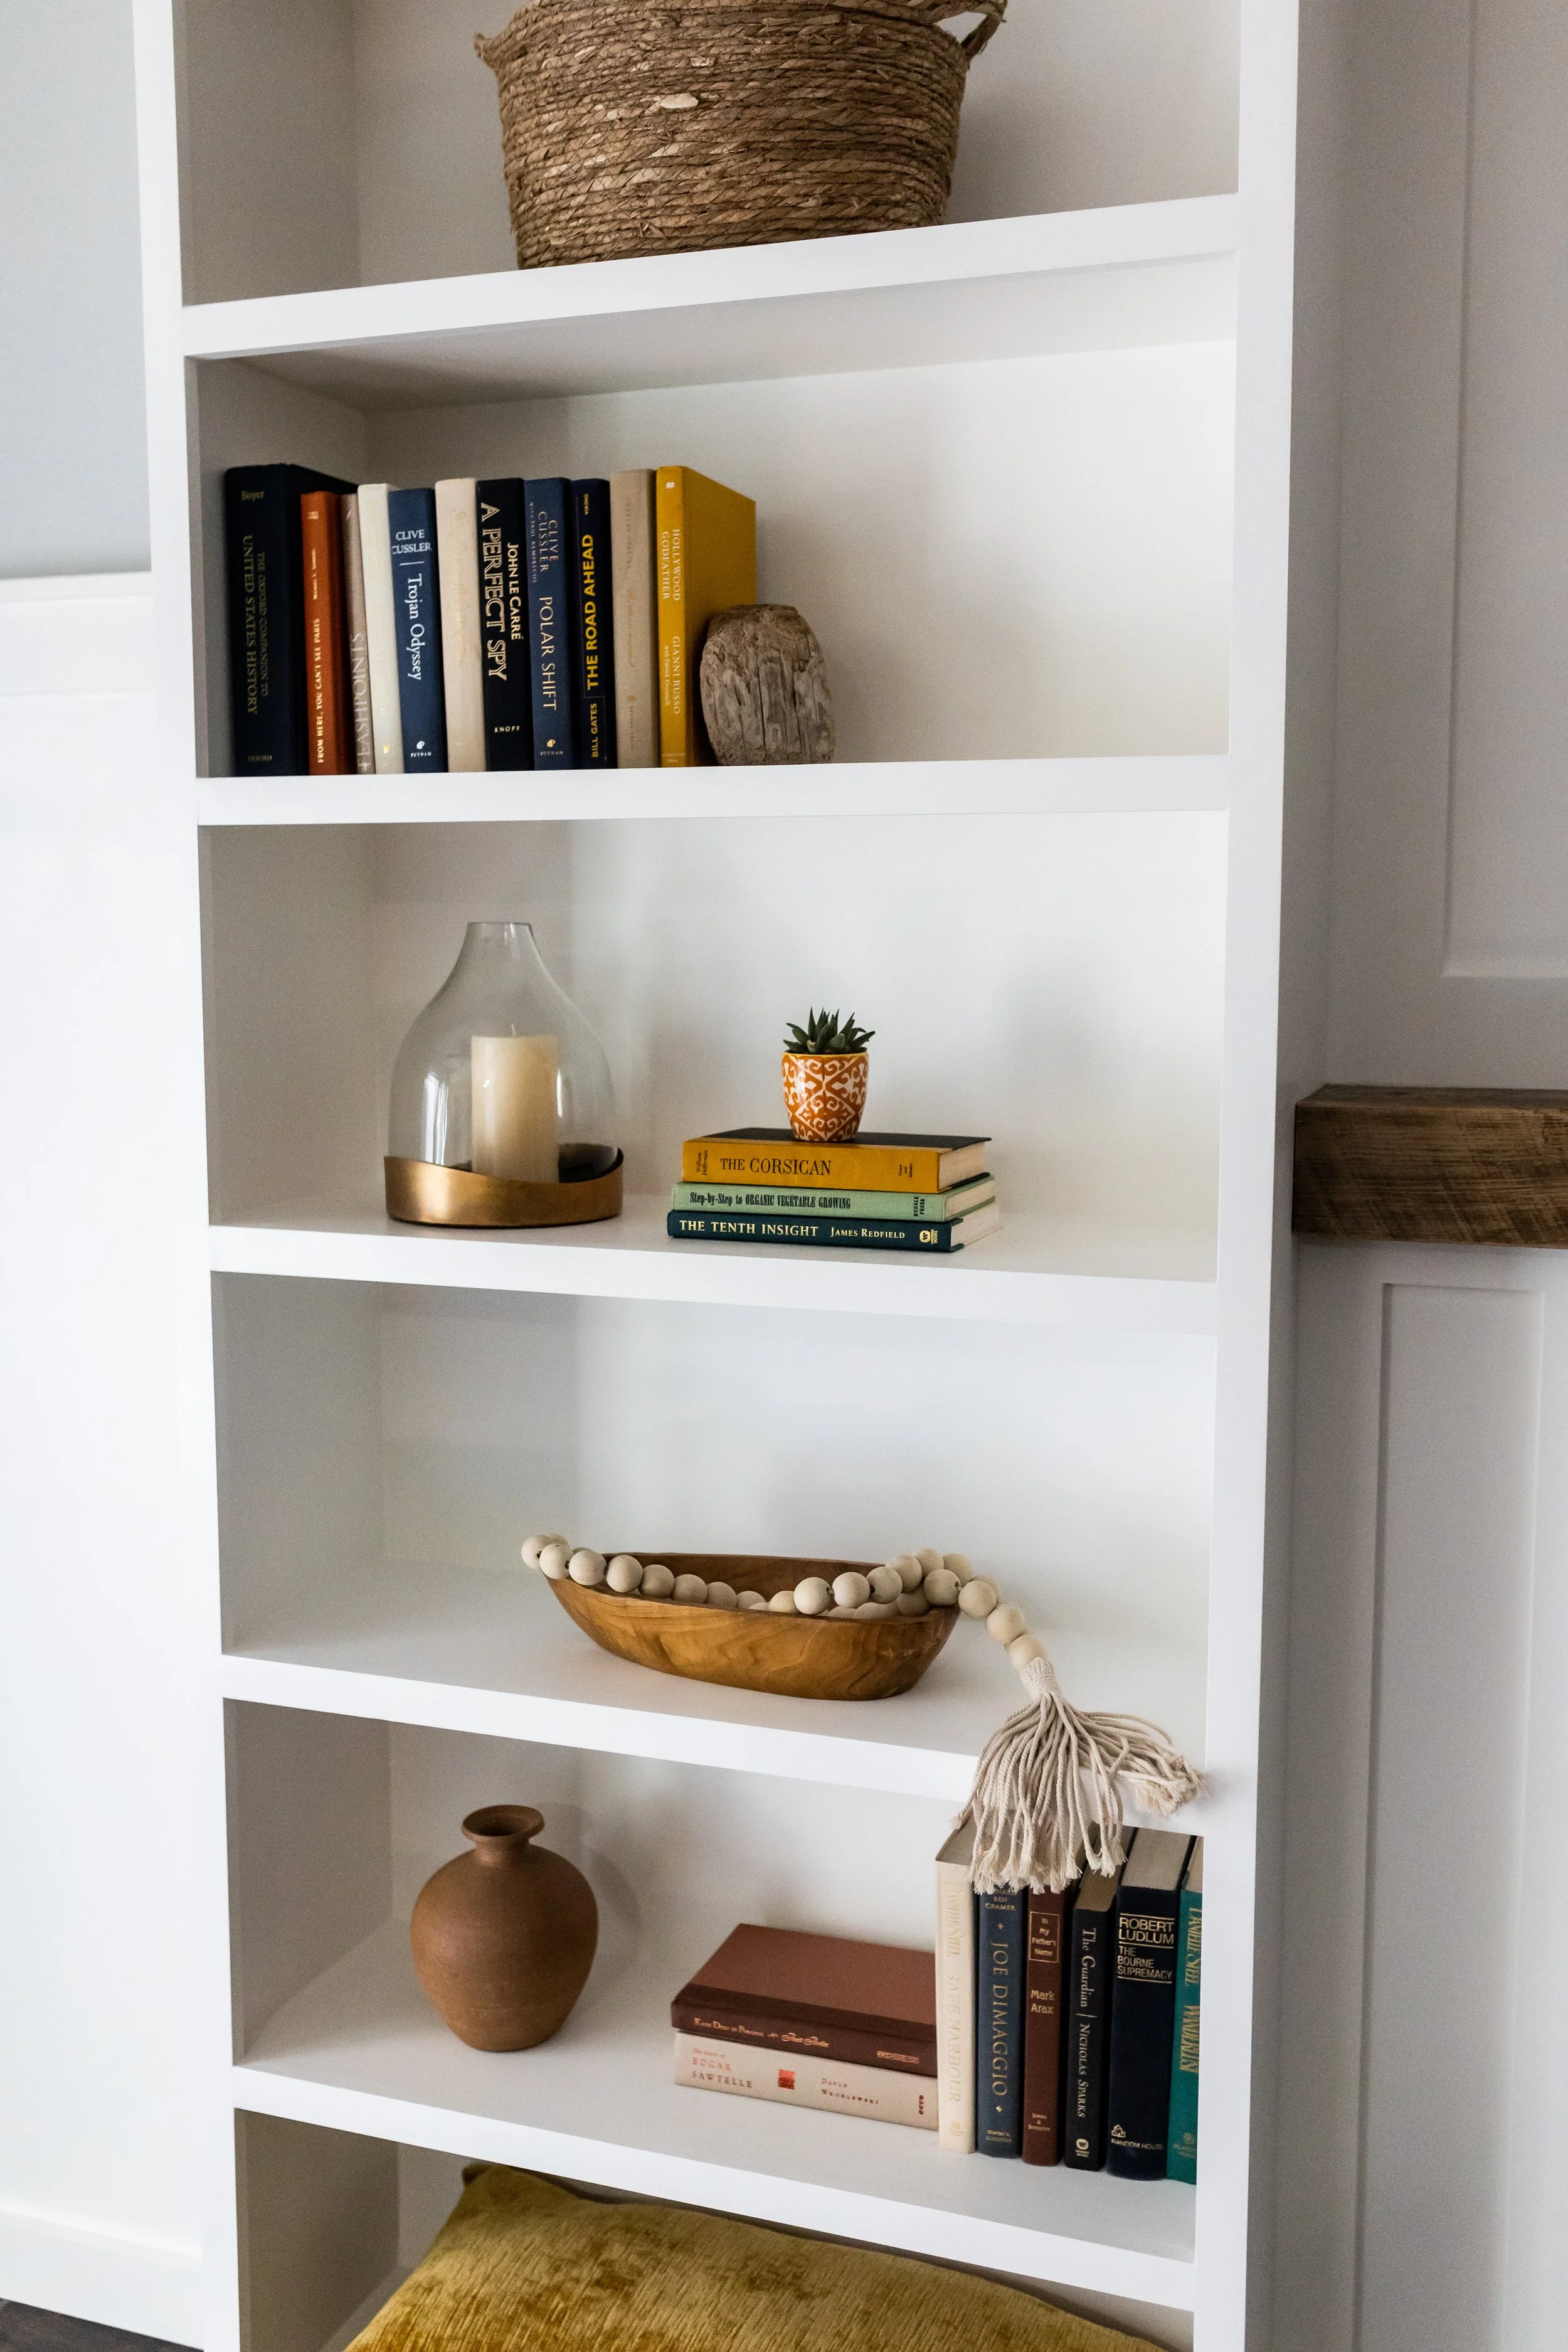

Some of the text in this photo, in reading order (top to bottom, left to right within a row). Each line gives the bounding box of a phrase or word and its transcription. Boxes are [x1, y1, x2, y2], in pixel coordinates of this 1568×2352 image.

[396, 529, 425, 541] CLIVE
[538, 511, 549, 572] CUSSLER
[548, 520, 559, 563] CLIVE
[391, 541, 432, 556] CUSSLER
[661, 531, 670, 600] GODFATHER
[672, 529, 681, 601] HOLLYWOOD
[480, 502, 507, 681] A PERFECT SPY
[506, 541, 524, 640] JOHN LE CARRÉ
[582, 533, 598, 690] THE ROAD AHEAD
[243, 534, 258, 714] UNITED STATES HISTORY
[257, 552, 268, 696] THE OXFORD COMPANION TO
[404, 573, 425, 681] Trojan Odyssey
[539, 596, 557, 711] POLAR SHIFT
[314, 665, 322, 689] CAN'T
[351, 632, 371, 772] FLASHPOINTS
[316, 712, 324, 736] HERE,
[590, 702, 598, 733] GATES
[494, 725, 521, 733] KNOPF
[720, 1157, 832, 1176] THE CORSICAN
[690, 1191, 851, 1210] Step-by-Step to ORGANIC VEGETABLE GROWING
[679, 1220, 905, 1239] THE TENTH INSIGHT JAMES REDFIELD
[985, 1903, 1016, 1911] CRAMER
[1039, 1927, 1051, 1937] My
[1120, 1917, 1174, 1933] ROBERT
[1032, 1936, 1057, 1947] Father's
[1118, 1928, 1174, 1945] LUDLUM
[1034, 1947, 1054, 1957] Name
[1118, 1946, 1136, 1957] THE
[1118, 1956, 1154, 1969] BOURNE
[1117, 1966, 1172, 1980] SUPREMACY
[946, 1973, 960, 2015] SAFE
[1030, 1989, 1055, 2001] Mark
[1030, 2003, 1054, 2015] Arax
[992, 1942, 1009, 2096] JOE DIMAGGIO
[1078, 1927, 1096, 2117] The Guardian NICHOLAS SPARKS
[692, 2057, 731, 2071] EDGAR
[948, 2018, 961, 2103] HARBOUR
[691, 2070, 752, 2089] SAWTELLE
[821, 2078, 848, 2089] DAVID
[1111, 2138, 1140, 2149] RANDOM
[1141, 2141, 1164, 2151] HOUSE
